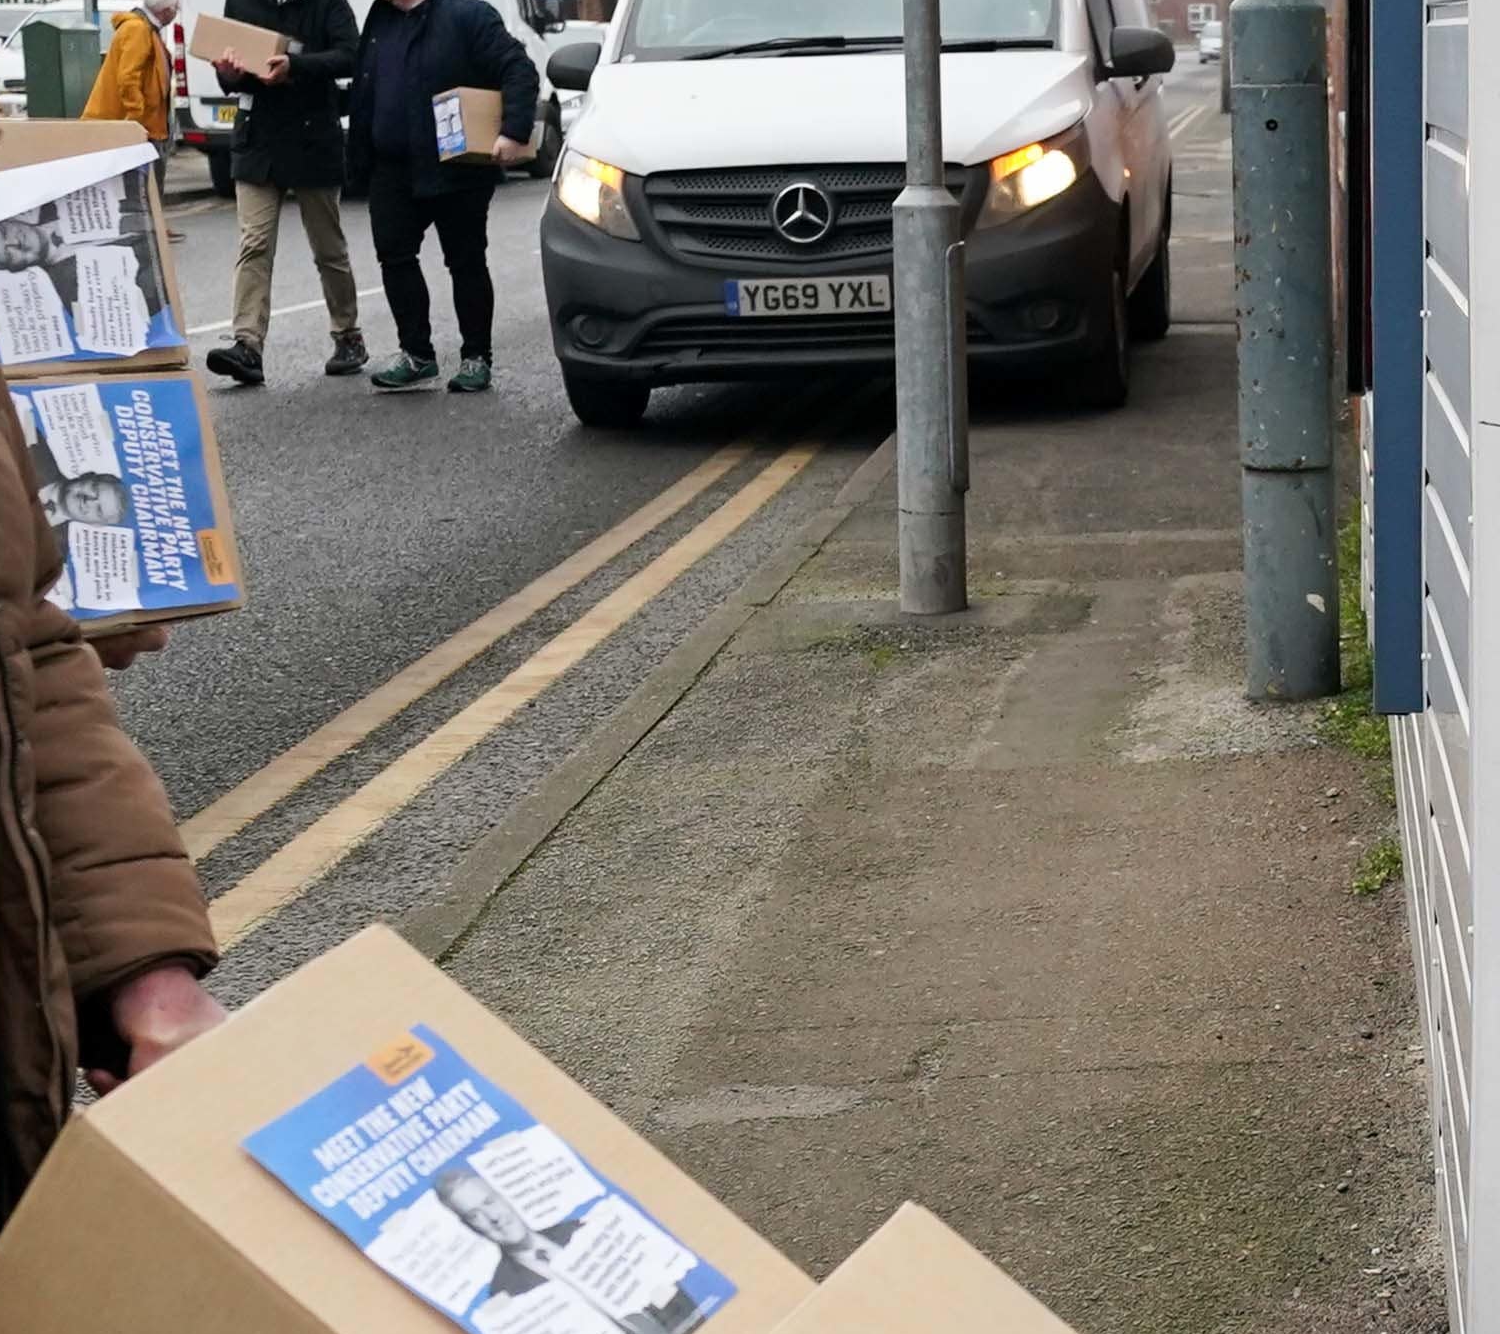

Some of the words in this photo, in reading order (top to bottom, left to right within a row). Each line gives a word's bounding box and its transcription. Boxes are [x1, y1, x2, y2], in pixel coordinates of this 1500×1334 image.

[743, 284, 819, 311] YG69
[828, 282, 885, 308] YXL
[115, 406, 146, 478] DEPUTY
[131, 485, 167, 584] CHAIRMAN
[132, 391, 173, 527] CONSERVATIVE
[158, 533, 188, 590] PARTY
[156, 422, 180, 471] MEET
[165, 477, 187, 510] THE
[173, 517, 198, 557] NEW
[309, 1113, 436, 1210] CONSERVATIVE
[421, 1077, 482, 1130] PARTY
[311, 1123, 368, 1173] MEET
[354, 1102, 401, 1142] THE
[386, 1075, 436, 1121] NEW
[345, 1159, 419, 1221] DEPUTY
[406, 1099, 503, 1178] CHAIRMAN
